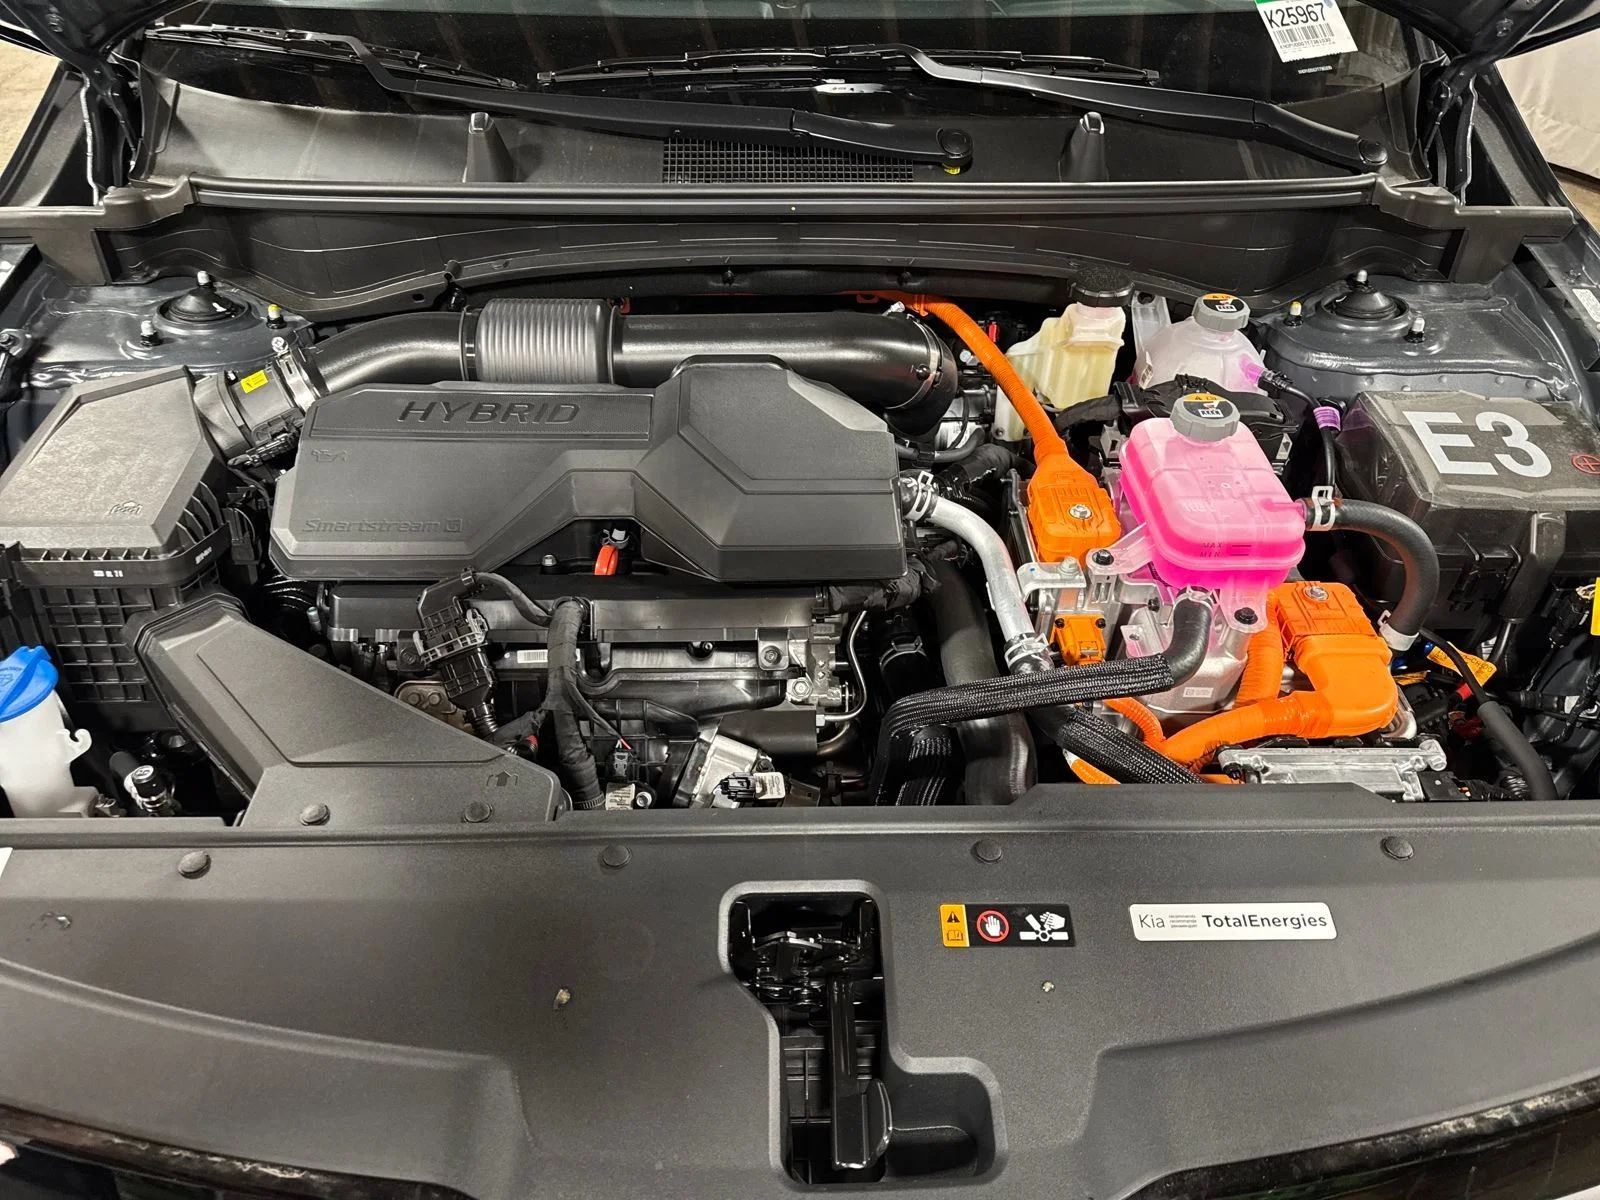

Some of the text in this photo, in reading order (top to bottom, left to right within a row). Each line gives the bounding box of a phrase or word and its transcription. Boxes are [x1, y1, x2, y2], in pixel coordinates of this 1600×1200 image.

[1264, 3, 1326, 28] K25967
[397, 401, 580, 424] HYBRID
[1402, 411, 1552, 478] E3
[302, 517, 441, 533] Smartstream
[1139, 914, 1165, 928] Kia
[1202, 913, 1327, 929] TotalEnergies
